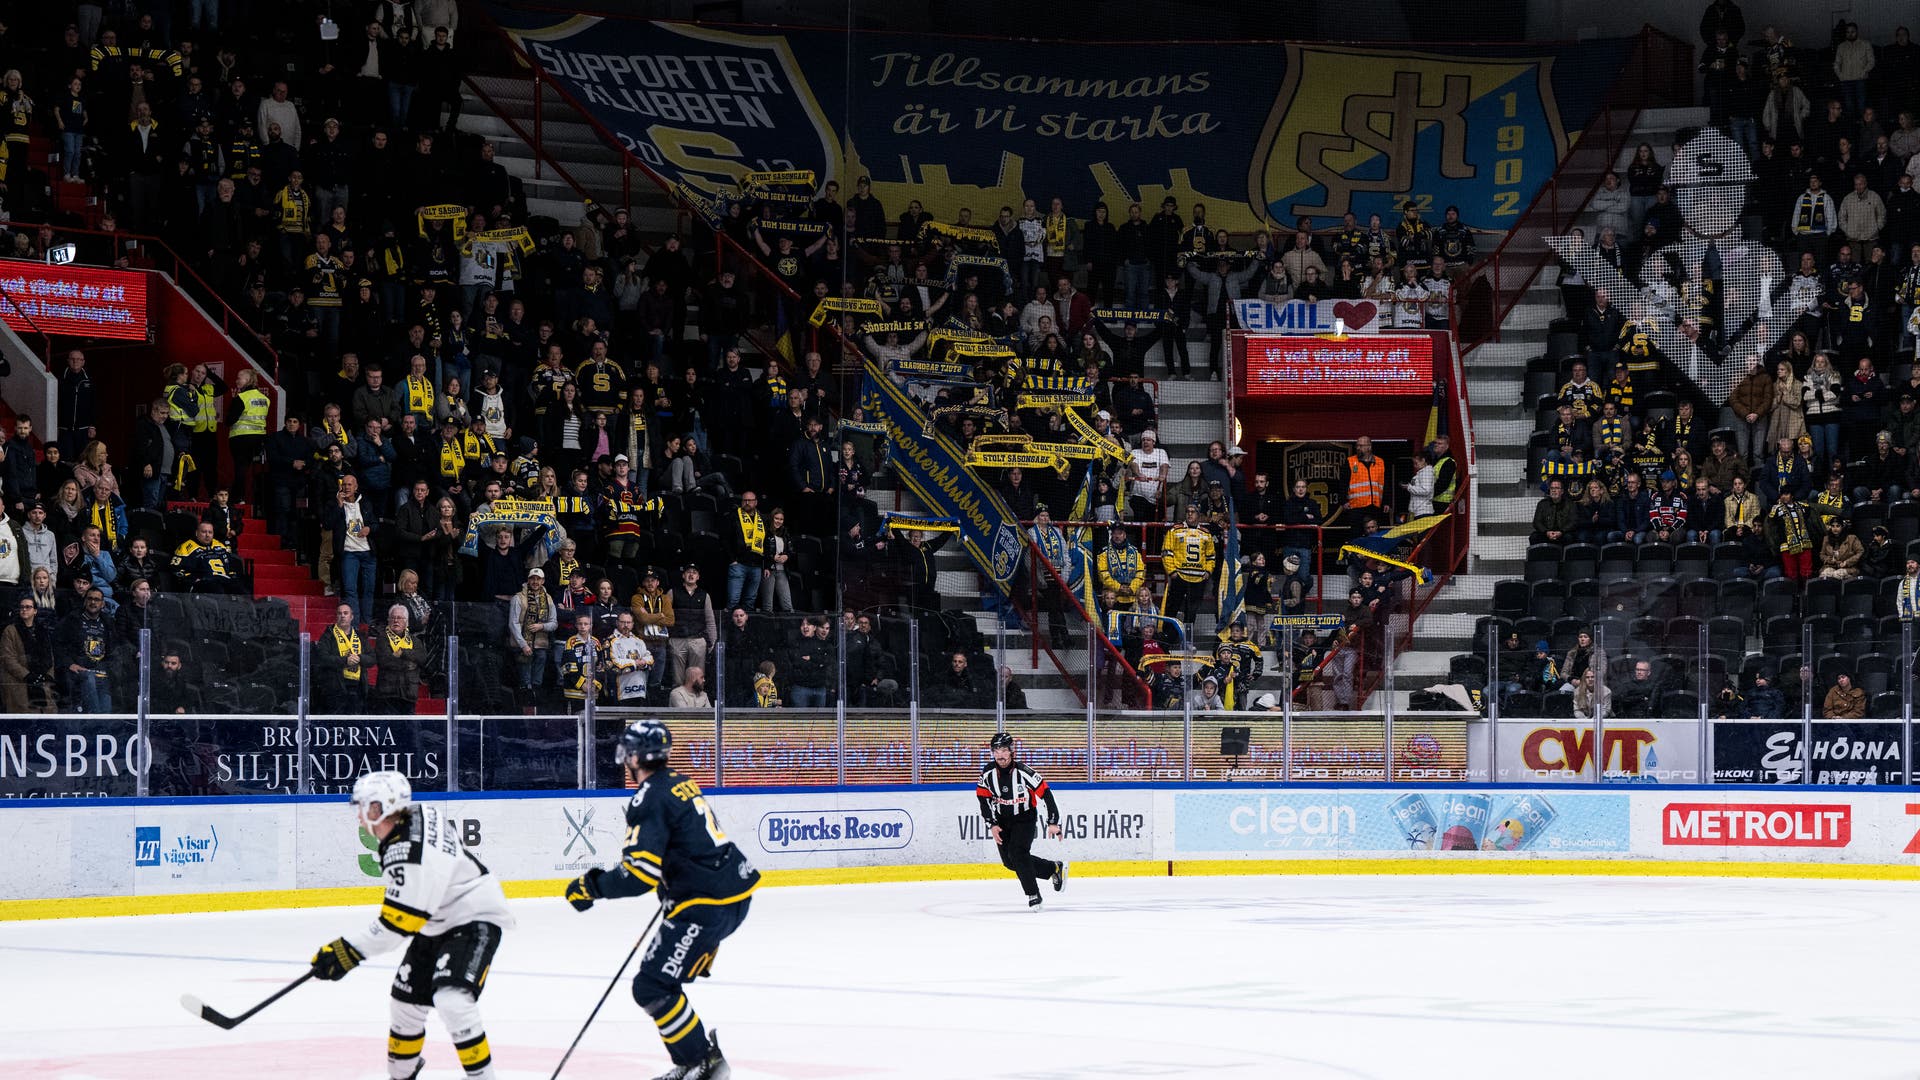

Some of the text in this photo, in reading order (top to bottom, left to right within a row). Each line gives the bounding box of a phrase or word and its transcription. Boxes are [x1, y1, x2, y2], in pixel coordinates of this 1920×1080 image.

[532, 42, 783, 95] SUPPORTER
[870, 52, 1211, 98] Tillsammans
[575, 81, 776, 129] KLUBBEN
[893, 103, 1221, 142] är vi starka
[1242, 303, 1330, 329] EMIL
[1289, 450, 1347, 469] SUPPORTER
[1294, 465, 1341, 481] KLUBBEN
[1521, 726, 1658, 776] CWT
[1230, 798, 1356, 835] clean
[1443, 798, 1486, 821] clean
[769, 814, 903, 846] Björcks Resor
[1094, 810, 1144, 840] HÄR?
[1668, 810, 1845, 841] METROLIT
[137, 840, 160, 861] LT
[164, 849, 204, 866] vägen.
[178, 835, 210, 850] Visar
